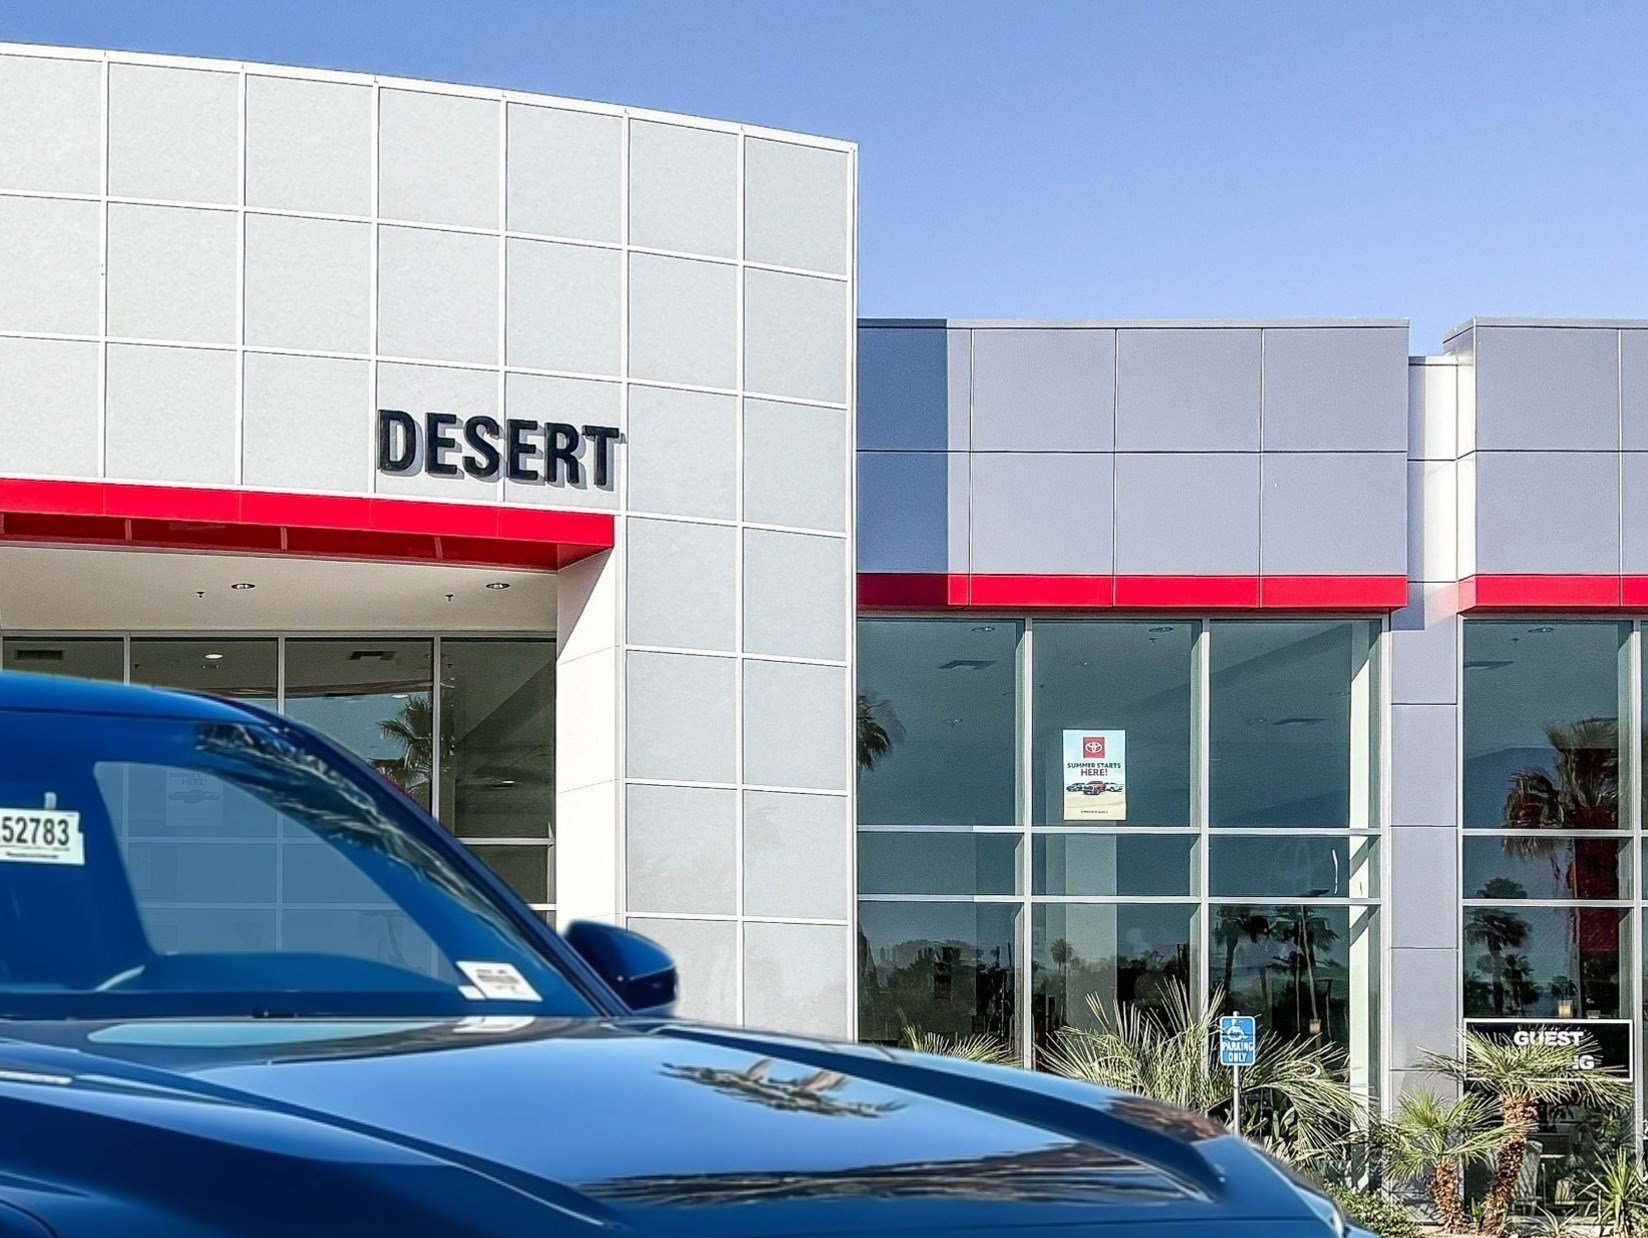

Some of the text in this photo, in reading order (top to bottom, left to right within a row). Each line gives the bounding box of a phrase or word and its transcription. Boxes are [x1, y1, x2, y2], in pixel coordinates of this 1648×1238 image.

[377, 409, 620, 487] DESERT
[1080, 768, 1108, 777] HERE!
[1513, 1030, 1584, 1047] GUEST
[1221, 1040, 1253, 1052] PARKING
[1228, 1051, 1248, 1063] ONLY
